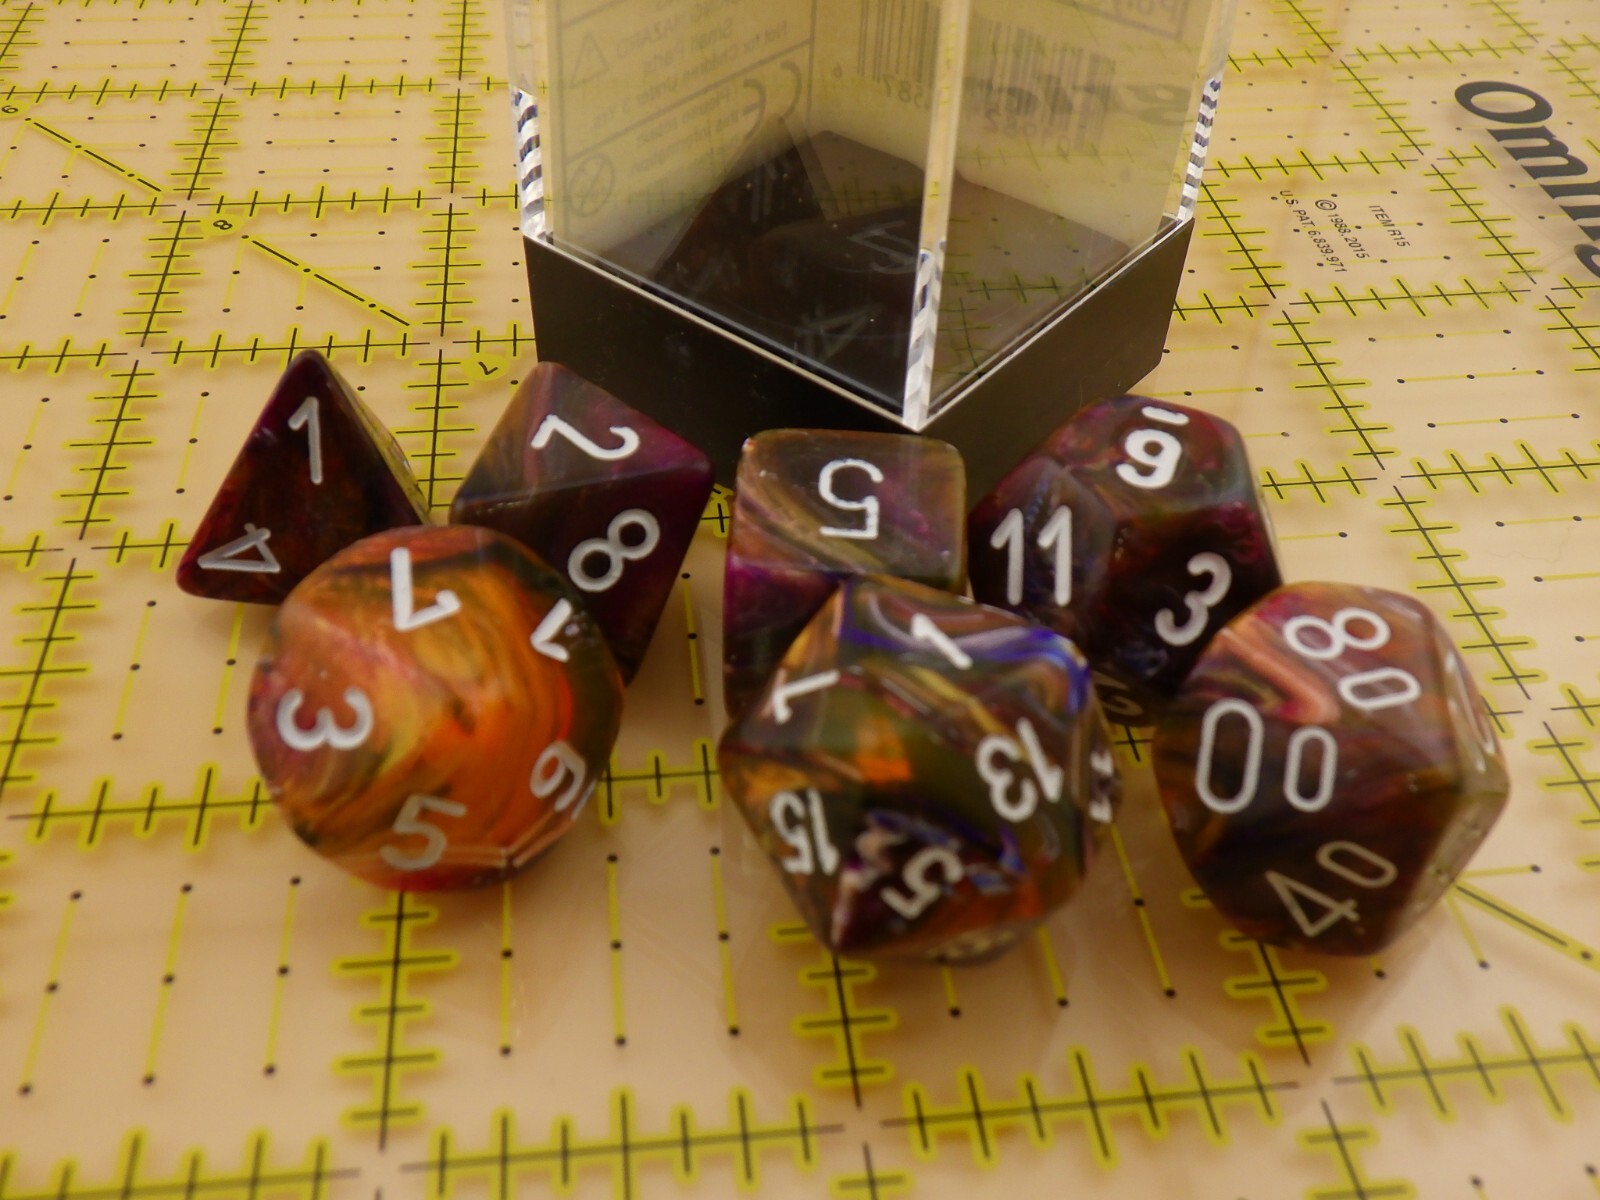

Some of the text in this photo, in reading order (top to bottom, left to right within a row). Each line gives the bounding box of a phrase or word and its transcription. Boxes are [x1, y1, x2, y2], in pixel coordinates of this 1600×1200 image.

[212, 220, 233, 230] 8
[1368, 205, 1411, 247] ITEM R15
[288, 396, 324, 485] 1
[818, 457, 884, 540] 5
[197, 523, 282, 573] 4
[567, 508, 661, 592] 8
[990, 505, 1074, 607] 11
[1154, 551, 1233, 647] 3
[276, 687, 374, 752] 3
[1195, 699, 1338, 815] 00
[975, 716, 1065, 824] 13
[379, 793, 468, 872] 5
[769, 786, 841, 877] 15
[880, 845, 965, 921] 5
[1265, 840, 1399, 938] 40
